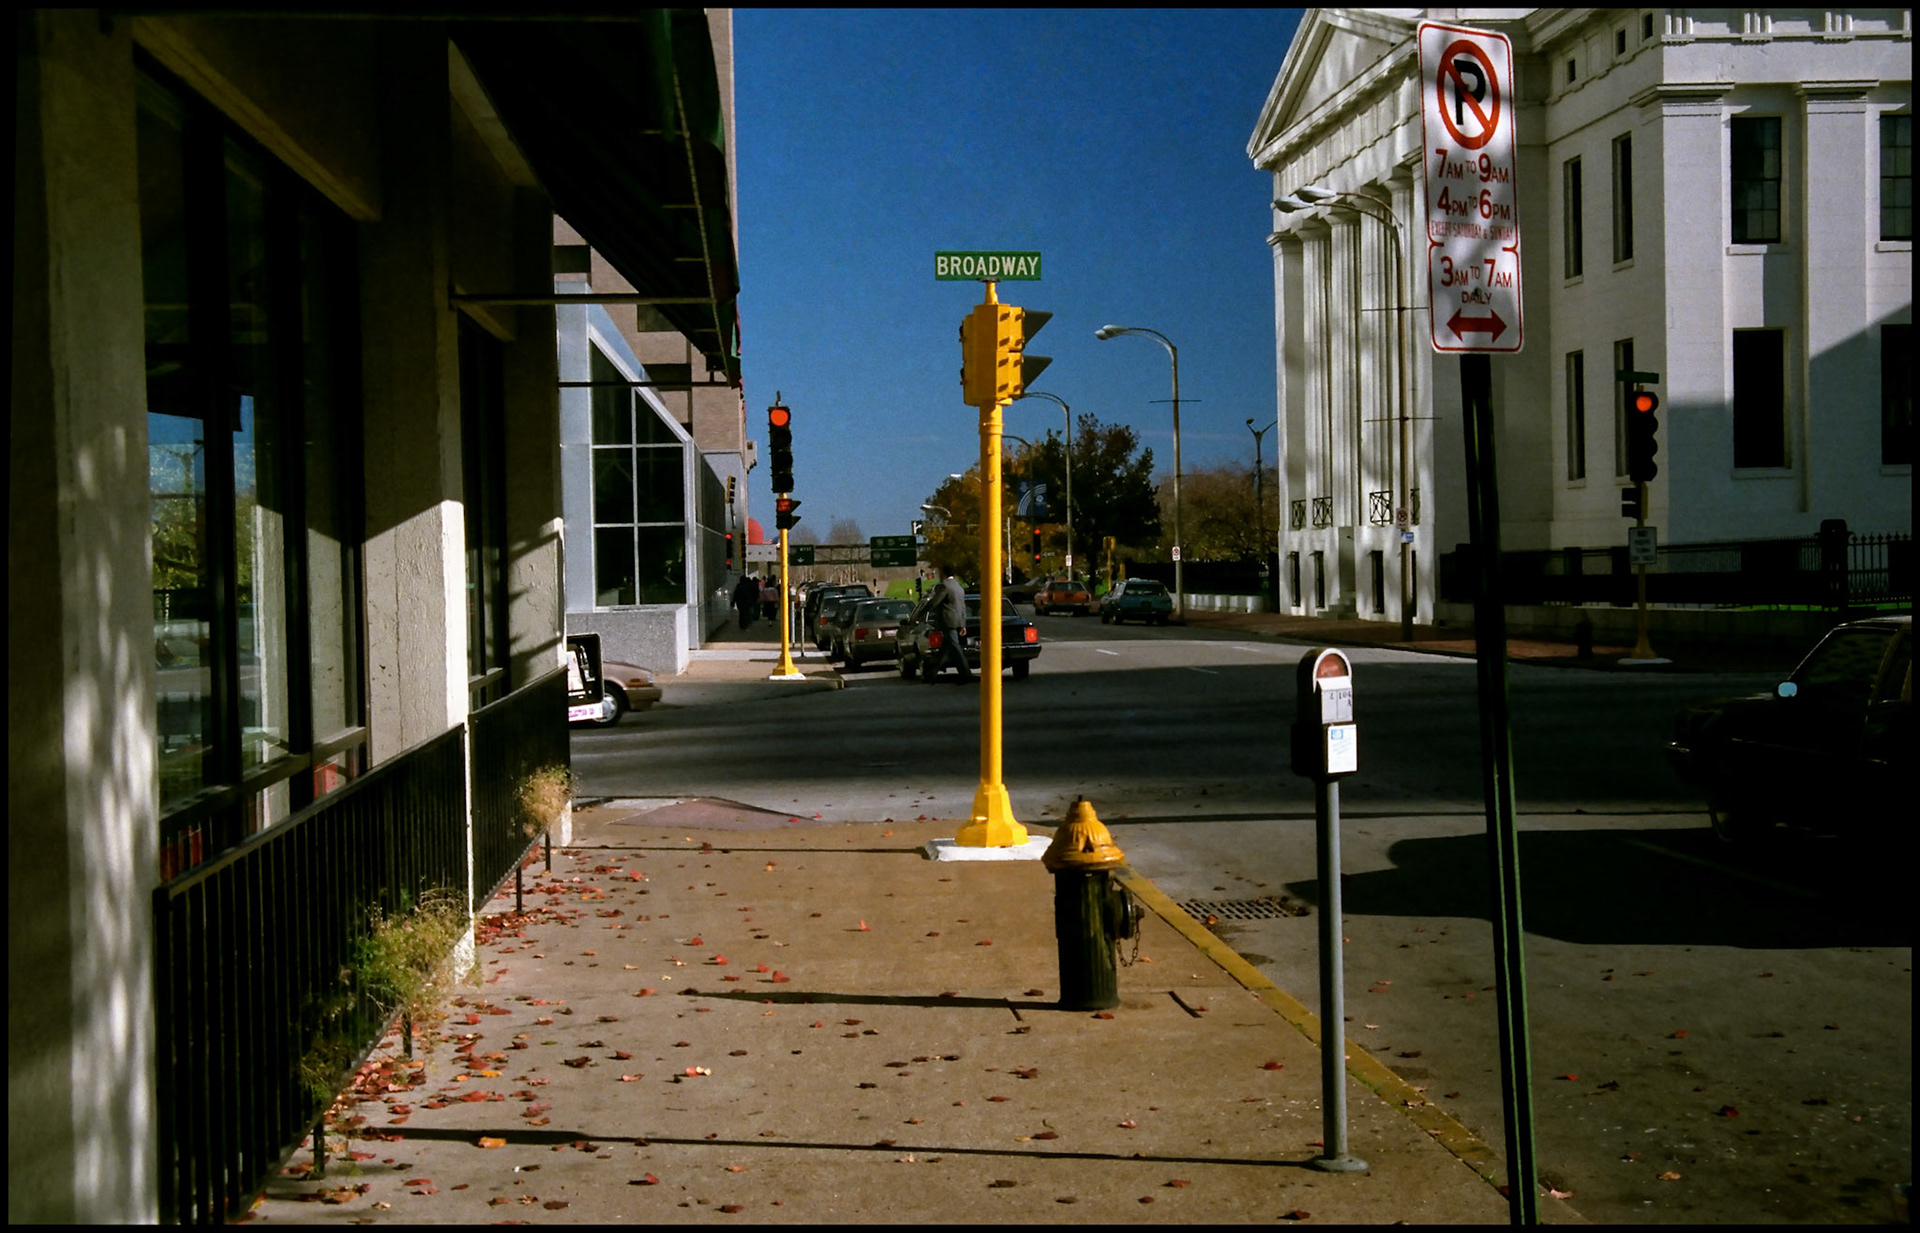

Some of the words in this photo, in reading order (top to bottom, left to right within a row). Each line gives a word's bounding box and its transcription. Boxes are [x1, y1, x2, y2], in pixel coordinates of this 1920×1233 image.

[1435, 148, 1464, 180] 7AM
[1465, 160, 1476, 174] TO
[1479, 153, 1509, 183] 9AM
[1437, 185, 1468, 217] 4PM
[1468, 195, 1478, 209] TO
[1479, 188, 1510, 220] 6PM
[937, 256, 1039, 276] BROADWAY
[1441, 256, 1469, 287] 3AM
[1470, 265, 1480, 280] TO
[1484, 258, 1512, 288] 7AM
[1461, 291, 1492, 305] DAILY
